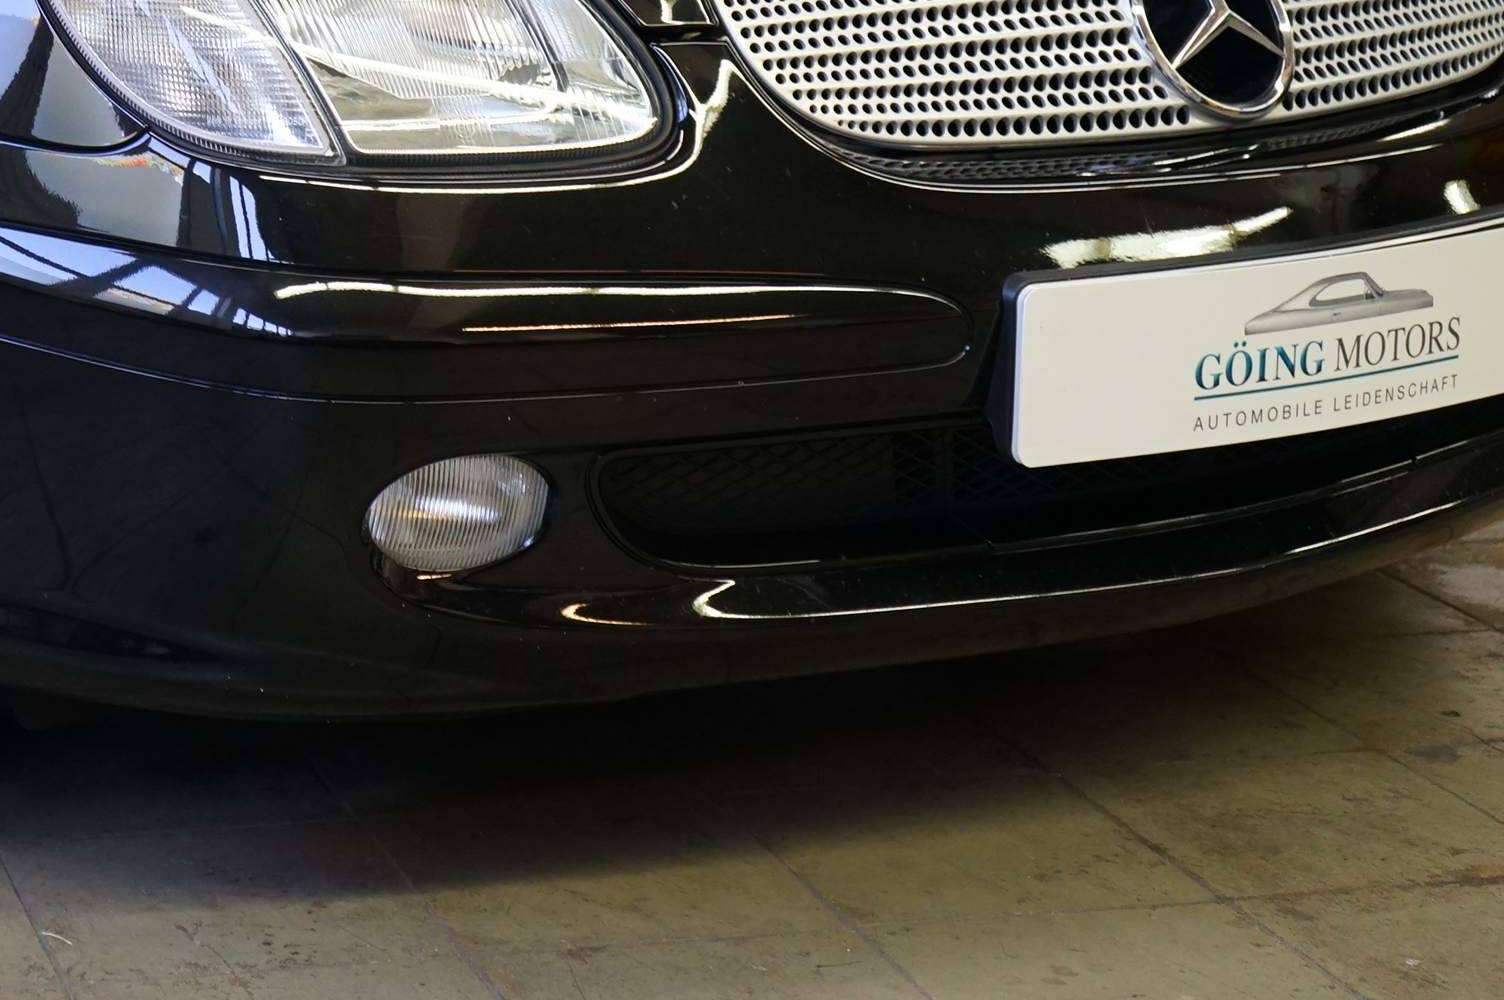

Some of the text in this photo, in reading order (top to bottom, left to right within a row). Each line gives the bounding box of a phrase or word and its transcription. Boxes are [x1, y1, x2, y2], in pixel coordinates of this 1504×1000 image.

[1194, 316, 1461, 391] GÖING MOTORS
[1193, 374, 1459, 432] AUTOMOBILE LEIDENSCHAFT
